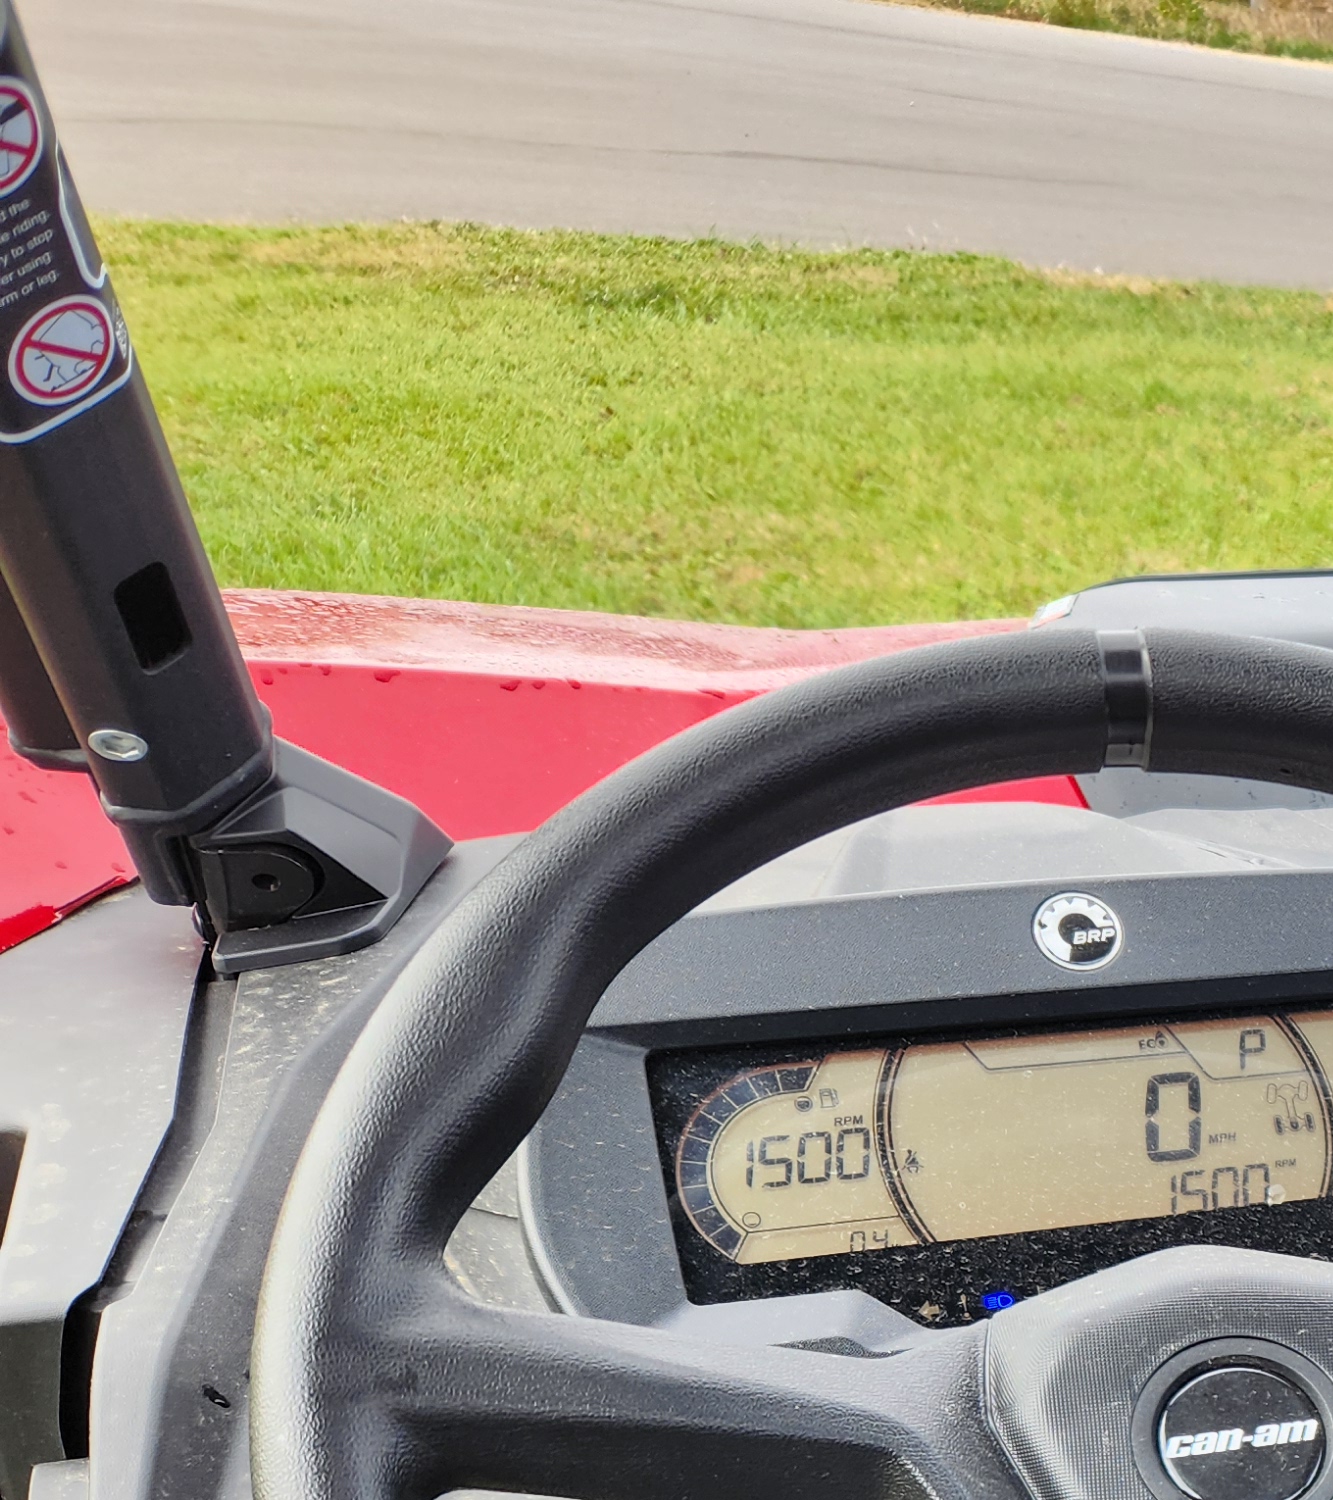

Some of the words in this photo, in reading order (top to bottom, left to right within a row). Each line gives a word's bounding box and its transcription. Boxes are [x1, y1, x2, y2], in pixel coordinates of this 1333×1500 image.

[8, 199, 30, 216] the
[26, 228, 54, 248] stop
[17, 251, 53, 277] using
[36, 269, 60, 288] leg.
[1073, 928, 1116, 945] BRP
[1240, 1029, 1266, 1070] P
[834, 1115, 863, 1126] RPM
[1145, 1072, 1201, 1162] 0
[1209, 1133, 1237, 1144] MPH
[746, 1127, 870, 1188] 1500
[1275, 1158, 1296, 1168] RPM
[1166, 1418, 1318, 1459] can-am
